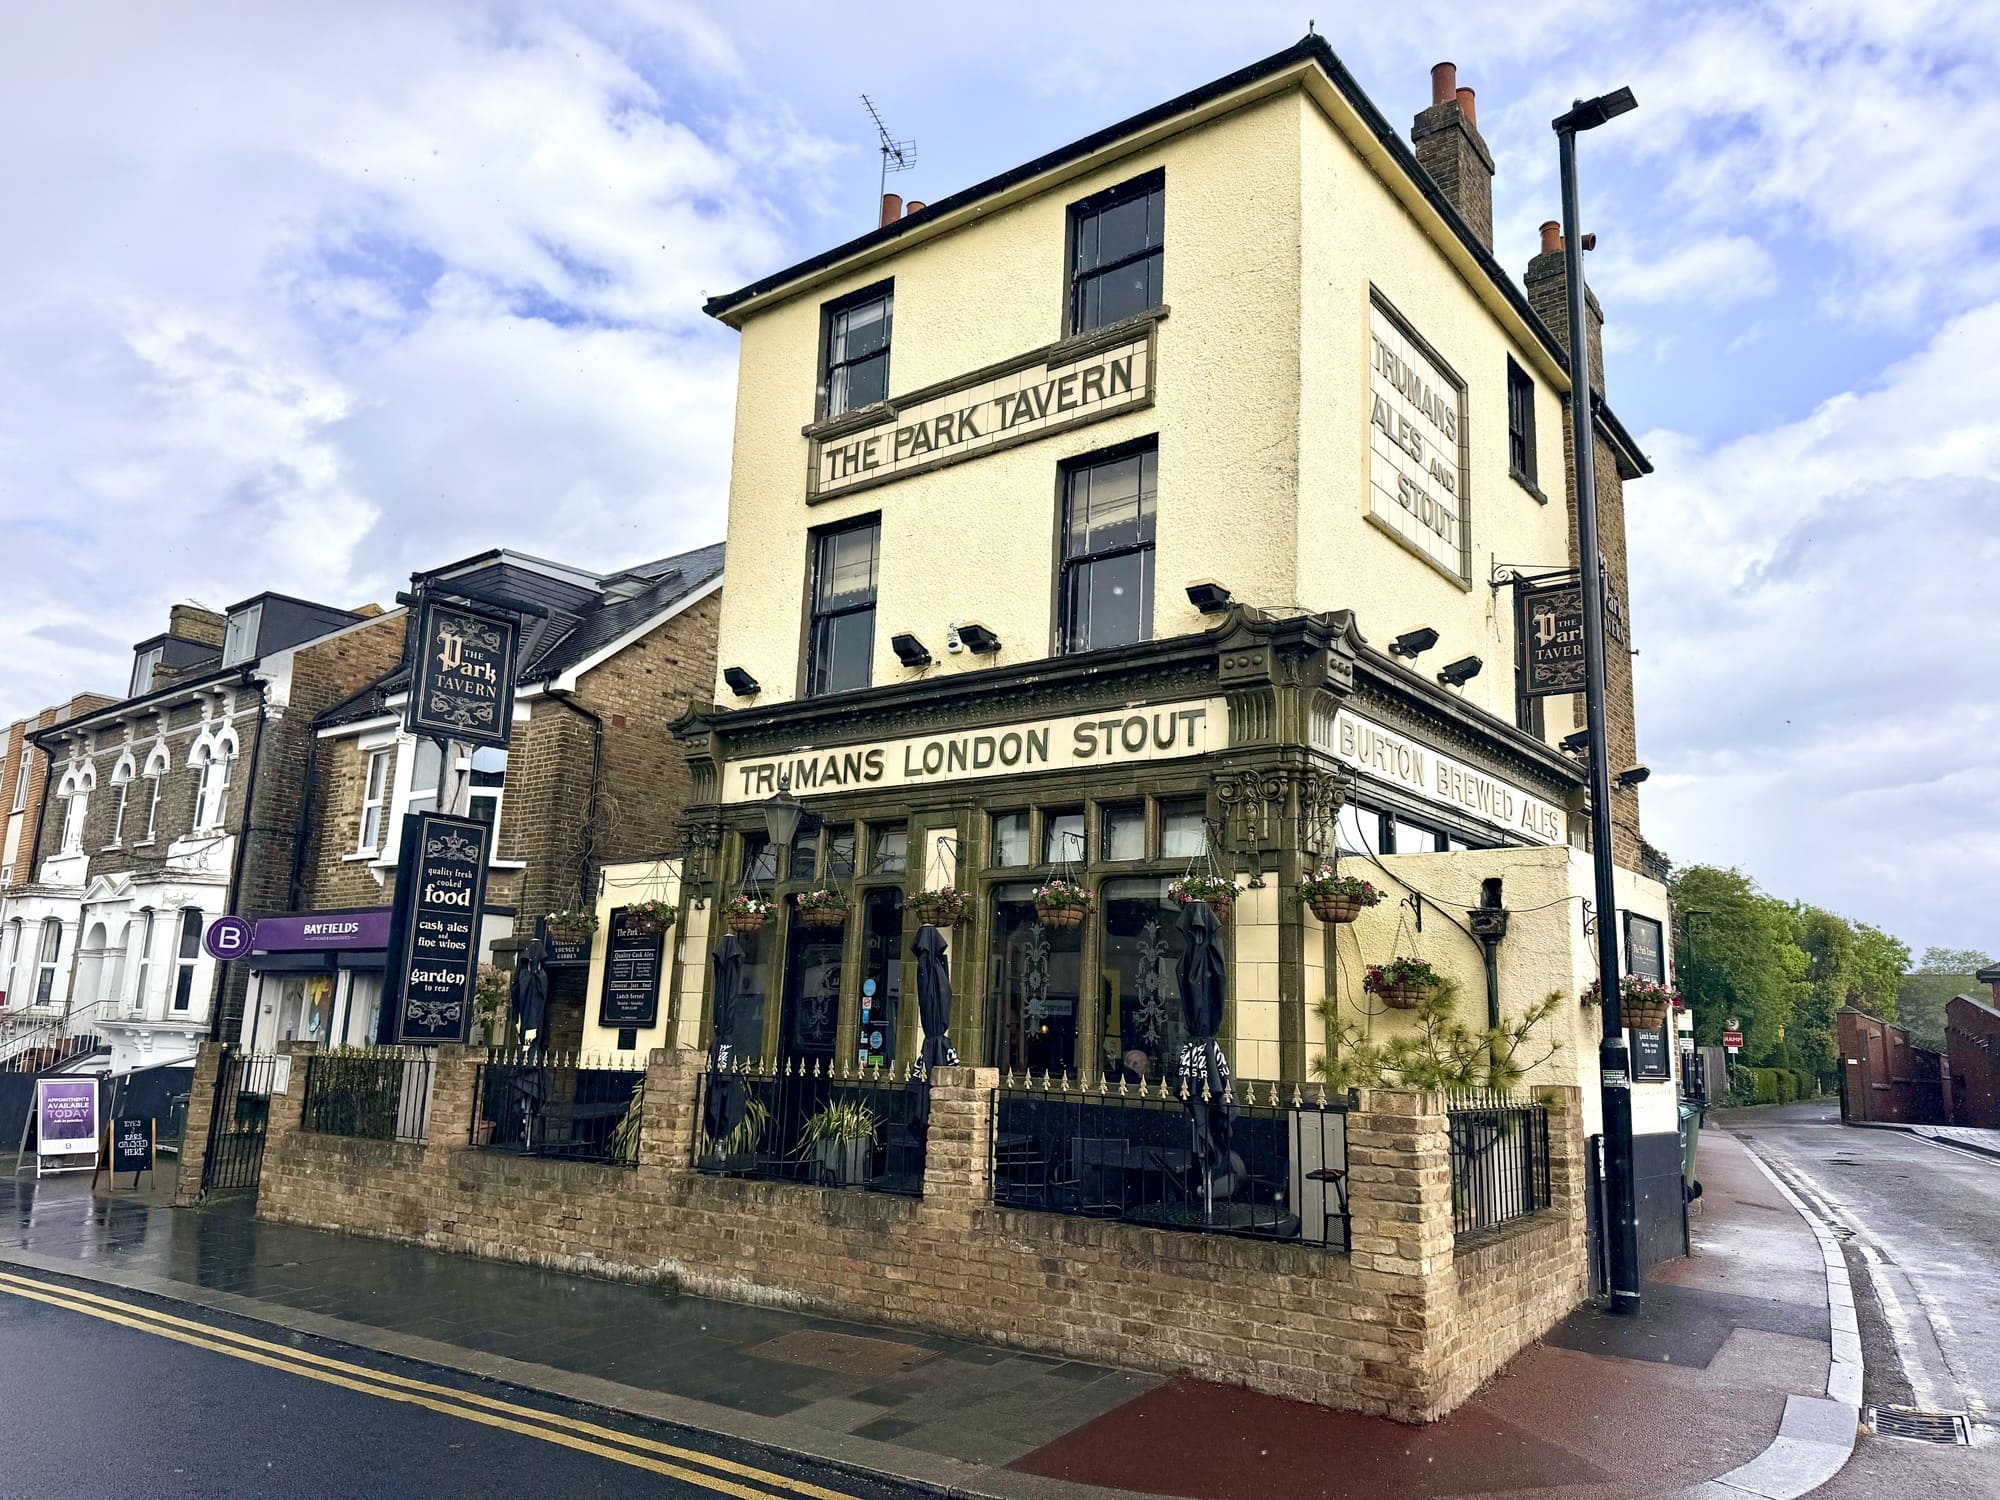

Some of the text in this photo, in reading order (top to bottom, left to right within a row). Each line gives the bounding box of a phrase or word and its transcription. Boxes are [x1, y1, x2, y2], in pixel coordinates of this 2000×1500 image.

[1372, 330, 1456, 441] TRUMANS
[826, 355, 1133, 480] THE PARK TAVERN
[1371, 393, 1455, 493] ALES AND
[1397, 471, 1456, 544] STOUT
[1559, 619, 1577, 628] THE
[436, 631, 497, 684] Park
[464, 649, 485, 661] THE
[1536, 645, 1582, 660] TAVER
[435, 674, 497, 699] TAVERN
[739, 709, 1206, 795] TRUMANS LONDON STOUT
[1339, 716, 1559, 842] BURTON BREWED ALES
[428, 867, 473, 879] quality fresh
[437, 879, 462, 888] cooked
[424, 883, 471, 907] food
[218, 922, 359, 949] B BAYFIELDS
[419, 921, 469, 933] cask ales
[418, 937, 467, 950] fine wines
[410, 968, 465, 986] garden
[47, 1109, 89, 1119] TODAY
[124, 1148, 145, 1157] HERE
